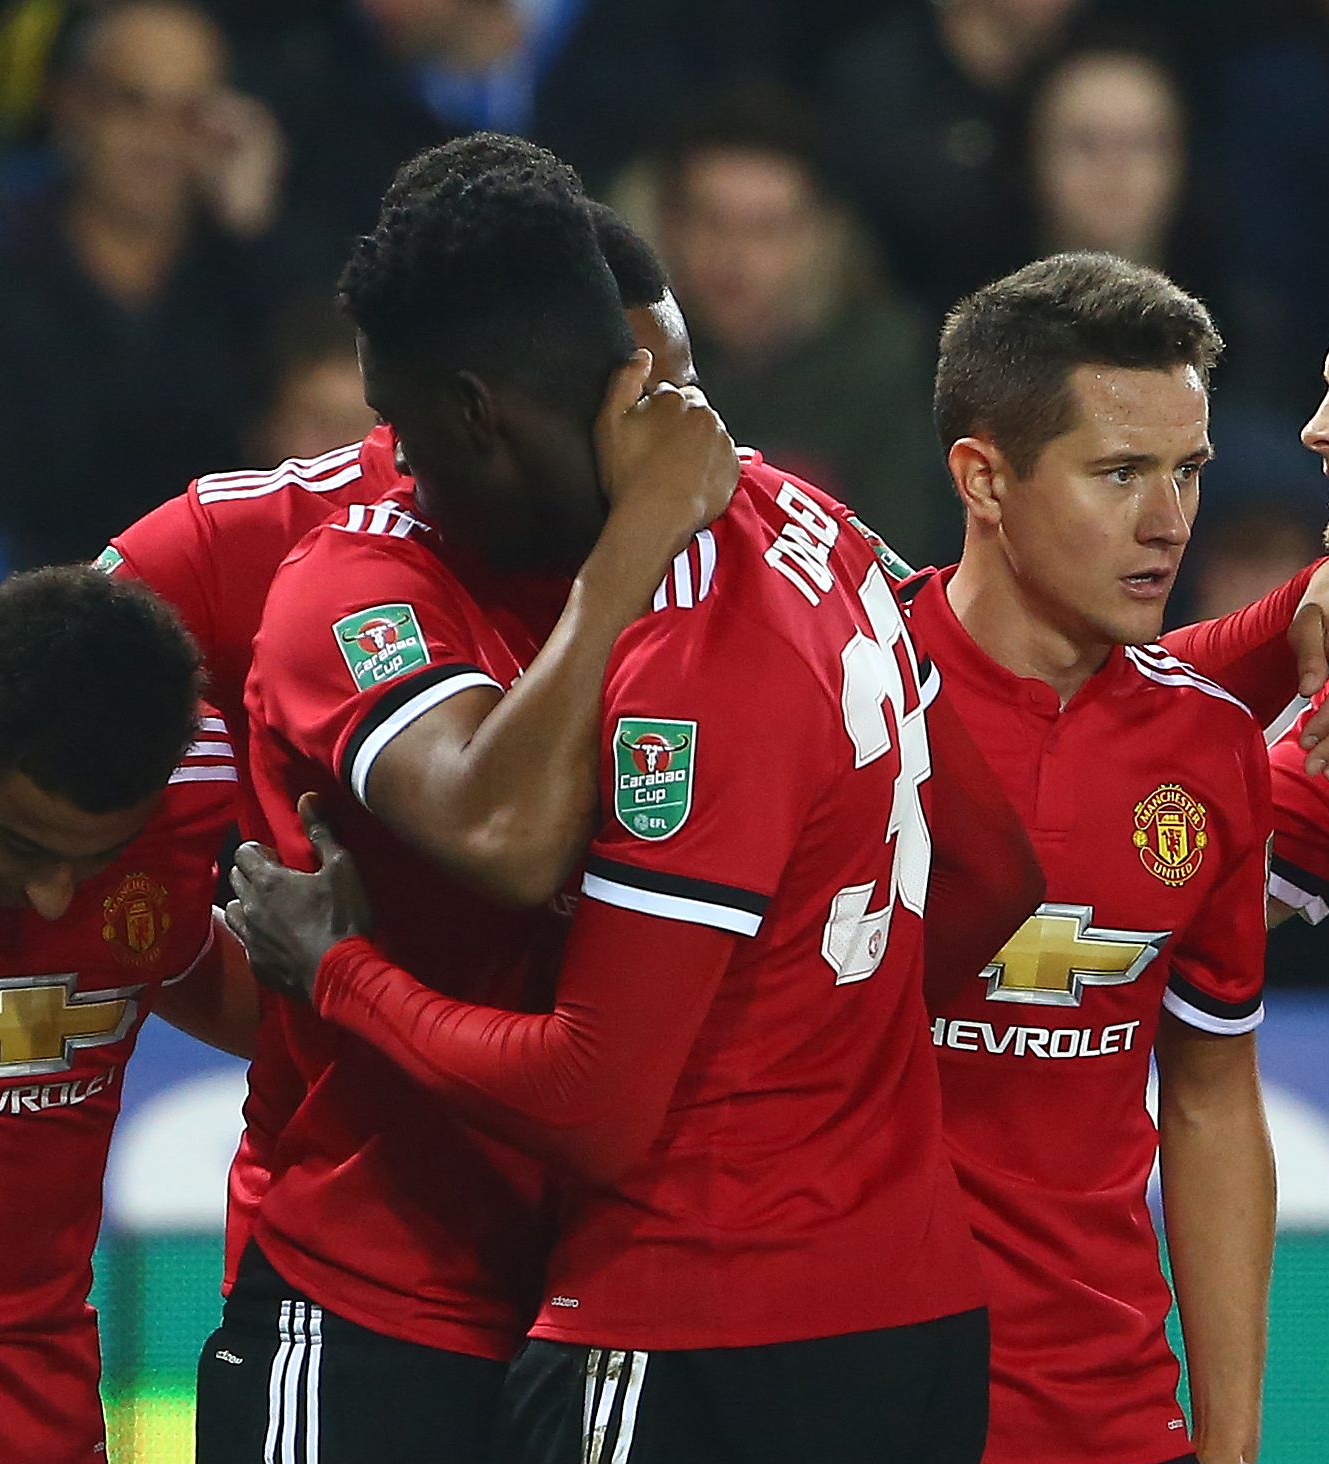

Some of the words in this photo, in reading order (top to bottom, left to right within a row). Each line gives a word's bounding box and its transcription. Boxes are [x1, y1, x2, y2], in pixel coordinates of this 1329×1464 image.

[355, 636, 417, 679] Carabao
[372, 654, 403, 681] Cup
[620, 769, 686, 789] Carabao
[635, 788, 666, 803] Cup
[1139, 791, 1201, 824] MANCHESTER
[649, 817, 668, 829] EFL
[1153, 861, 1193, 879] UNITED
[928, 1016, 1141, 1059] HEVROLET
